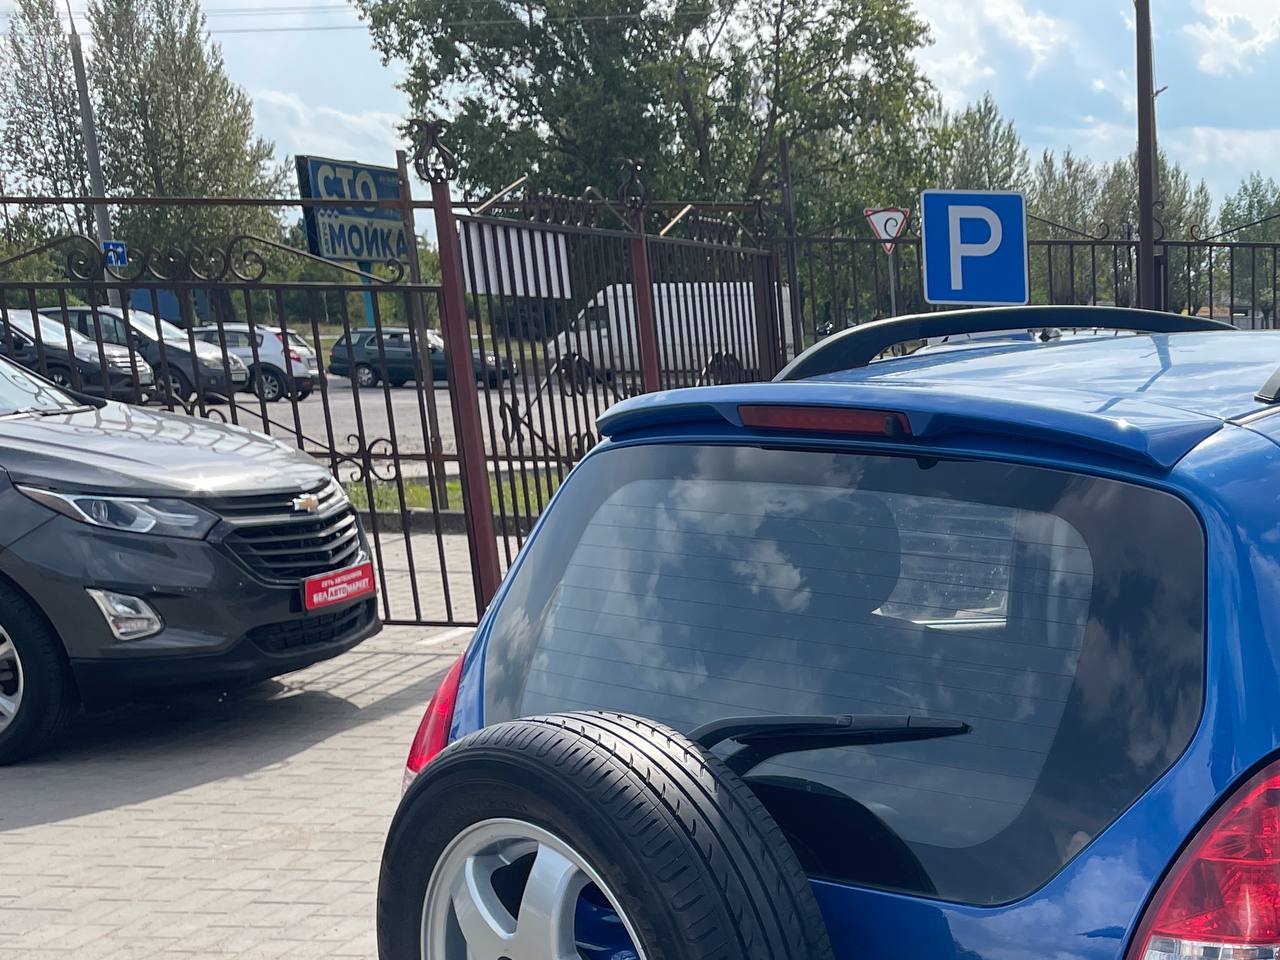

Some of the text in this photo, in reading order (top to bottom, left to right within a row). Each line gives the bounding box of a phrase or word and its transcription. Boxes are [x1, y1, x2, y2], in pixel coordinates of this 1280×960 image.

[317, 164, 378, 212] СТО
[328, 219, 409, 259] МОЙКА
[948, 205, 1003, 291] P
